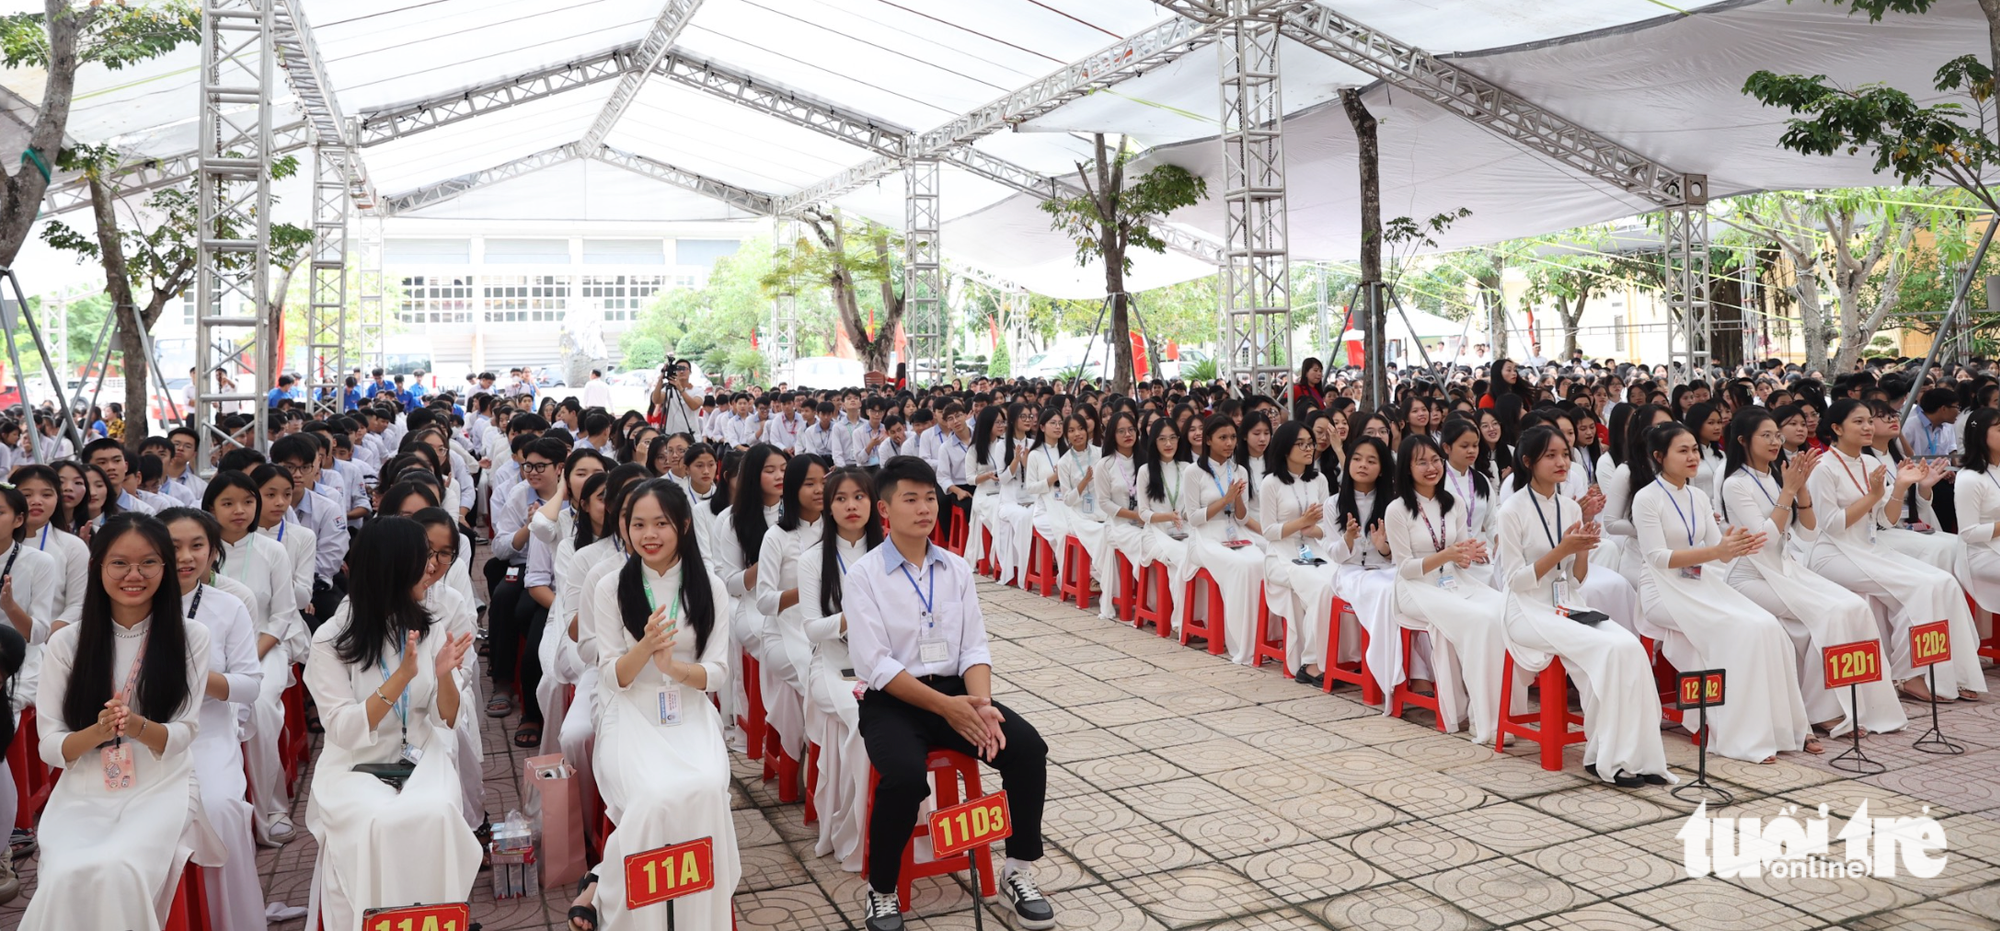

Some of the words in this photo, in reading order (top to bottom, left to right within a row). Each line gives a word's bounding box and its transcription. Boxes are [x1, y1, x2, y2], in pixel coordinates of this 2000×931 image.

[1915, 630, 1946, 658] 12D2
[1829, 650, 1875, 680] 12D1
[938, 805, 1004, 847] 11D3
[643, 850, 700, 894] 11A
